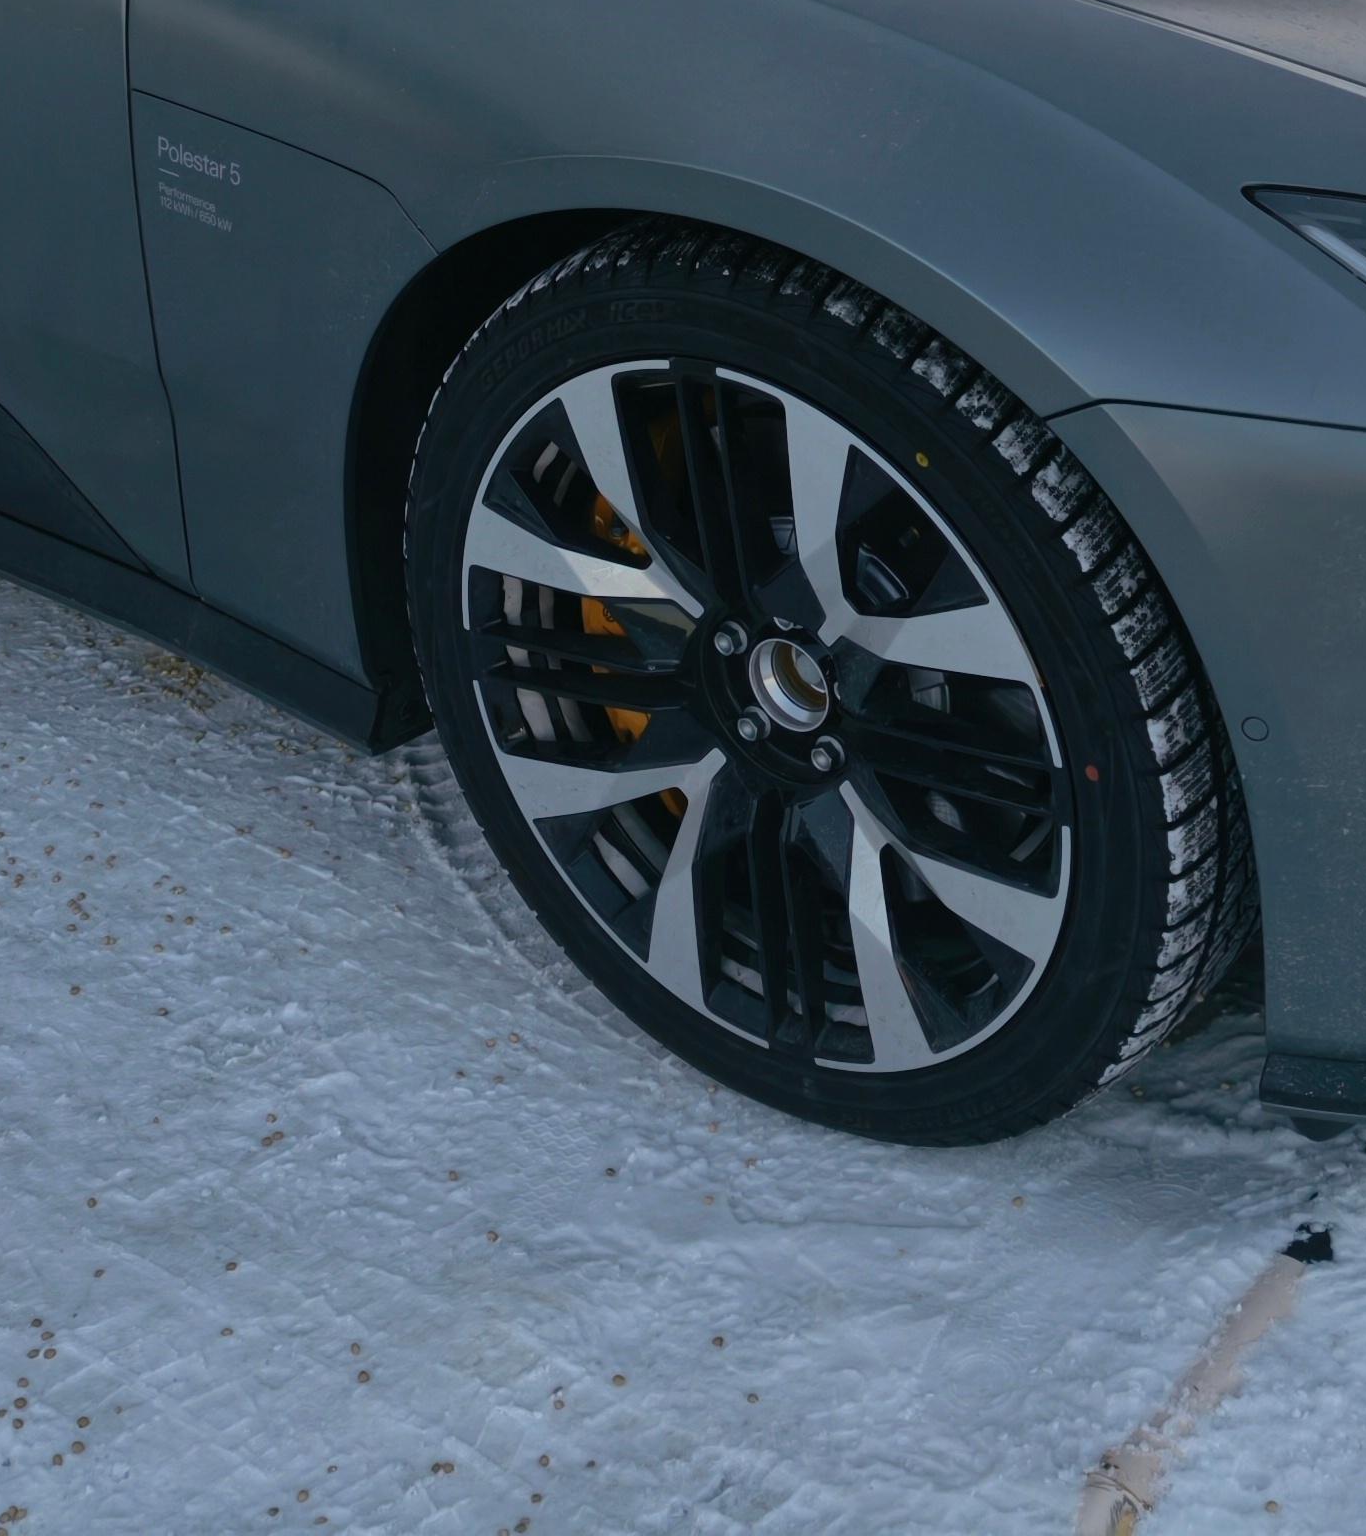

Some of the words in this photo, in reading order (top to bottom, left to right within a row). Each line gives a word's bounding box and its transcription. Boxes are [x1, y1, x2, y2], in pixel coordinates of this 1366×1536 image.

[157, 136, 226, 180] Polestar
[230, 162, 241, 186] 5
[158, 182, 216, 212] Performance
[217, 218, 233, 233] kW
